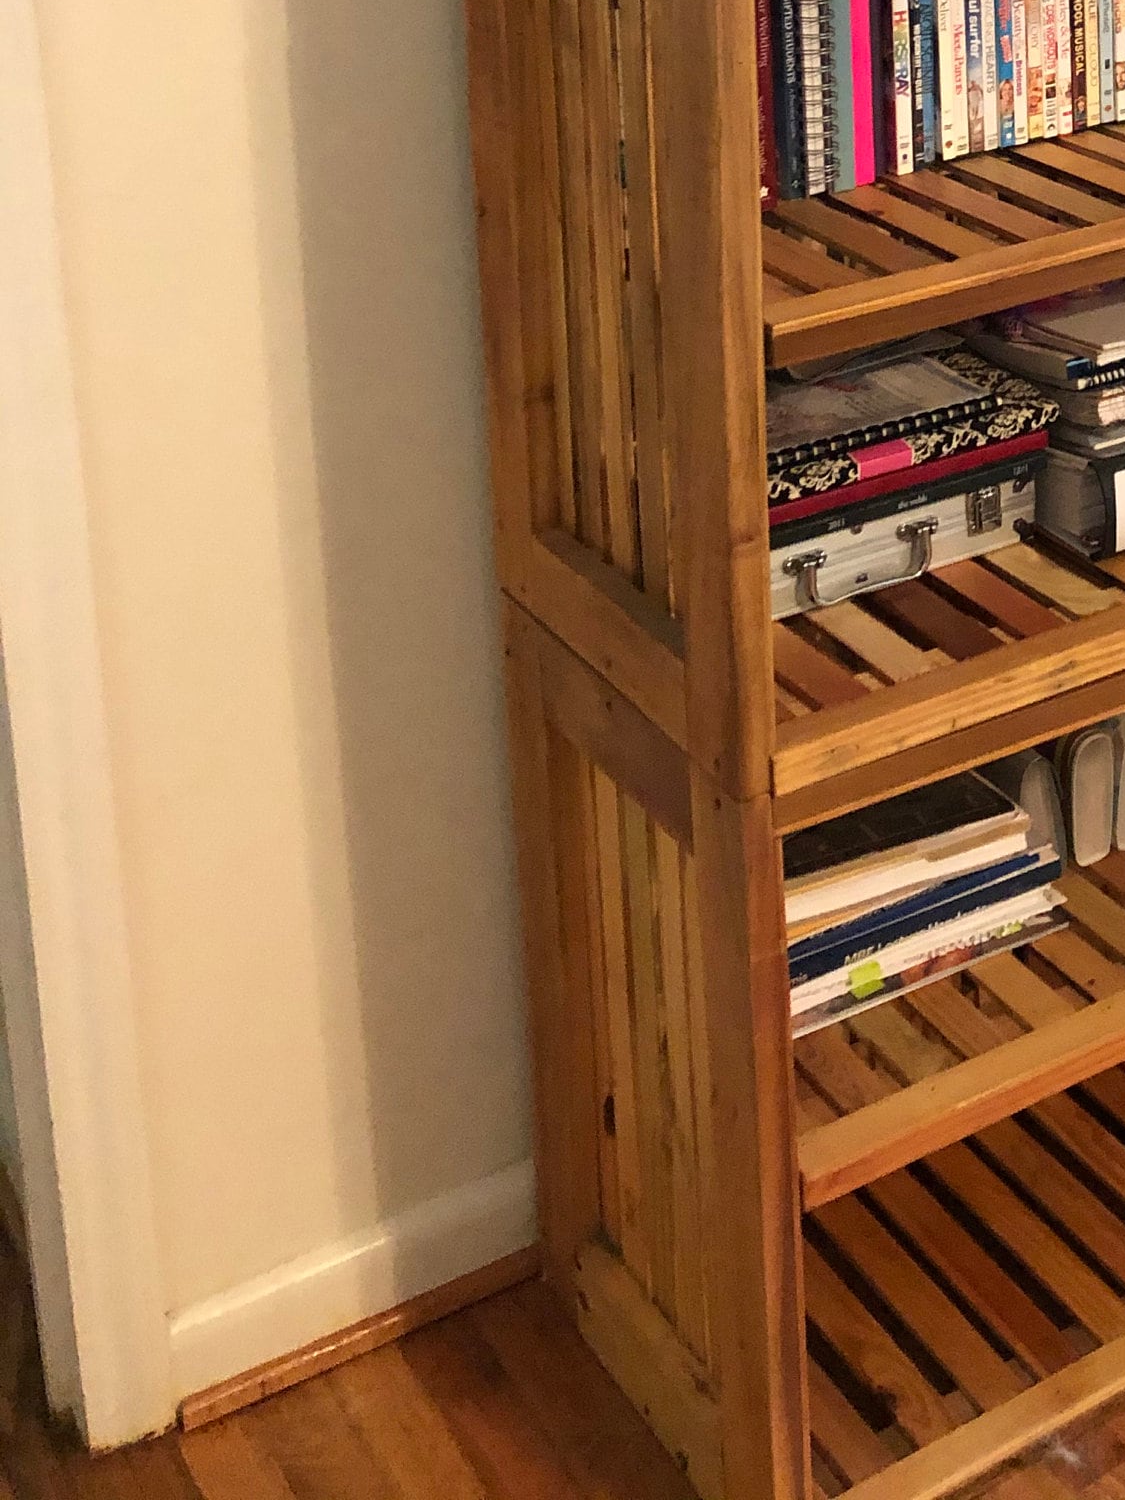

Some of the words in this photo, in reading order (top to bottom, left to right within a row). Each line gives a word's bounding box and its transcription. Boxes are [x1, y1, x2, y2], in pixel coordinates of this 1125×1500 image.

[918, 3, 932, 40] ABOUT
[952, 23, 964, 48] Meet
[1012, 0, 1024, 37] Beauty
[1045, 4, 1056, 25] CORE
[758, 15, 770, 67] Wedding
[784, 30, 796, 83] STUDENTS
[893, 10, 910, 99] HAIRSPRAY
[969, 15, 981, 59] surfer
[1046, 26, 1057, 70] WORKOUTS
[1061, 41, 1070, 59] Me
[1073, 28, 1085, 75] MUSICAL
[953, 56, 965, 95] Parents
[985, 45, 995, 94] HEARTS
